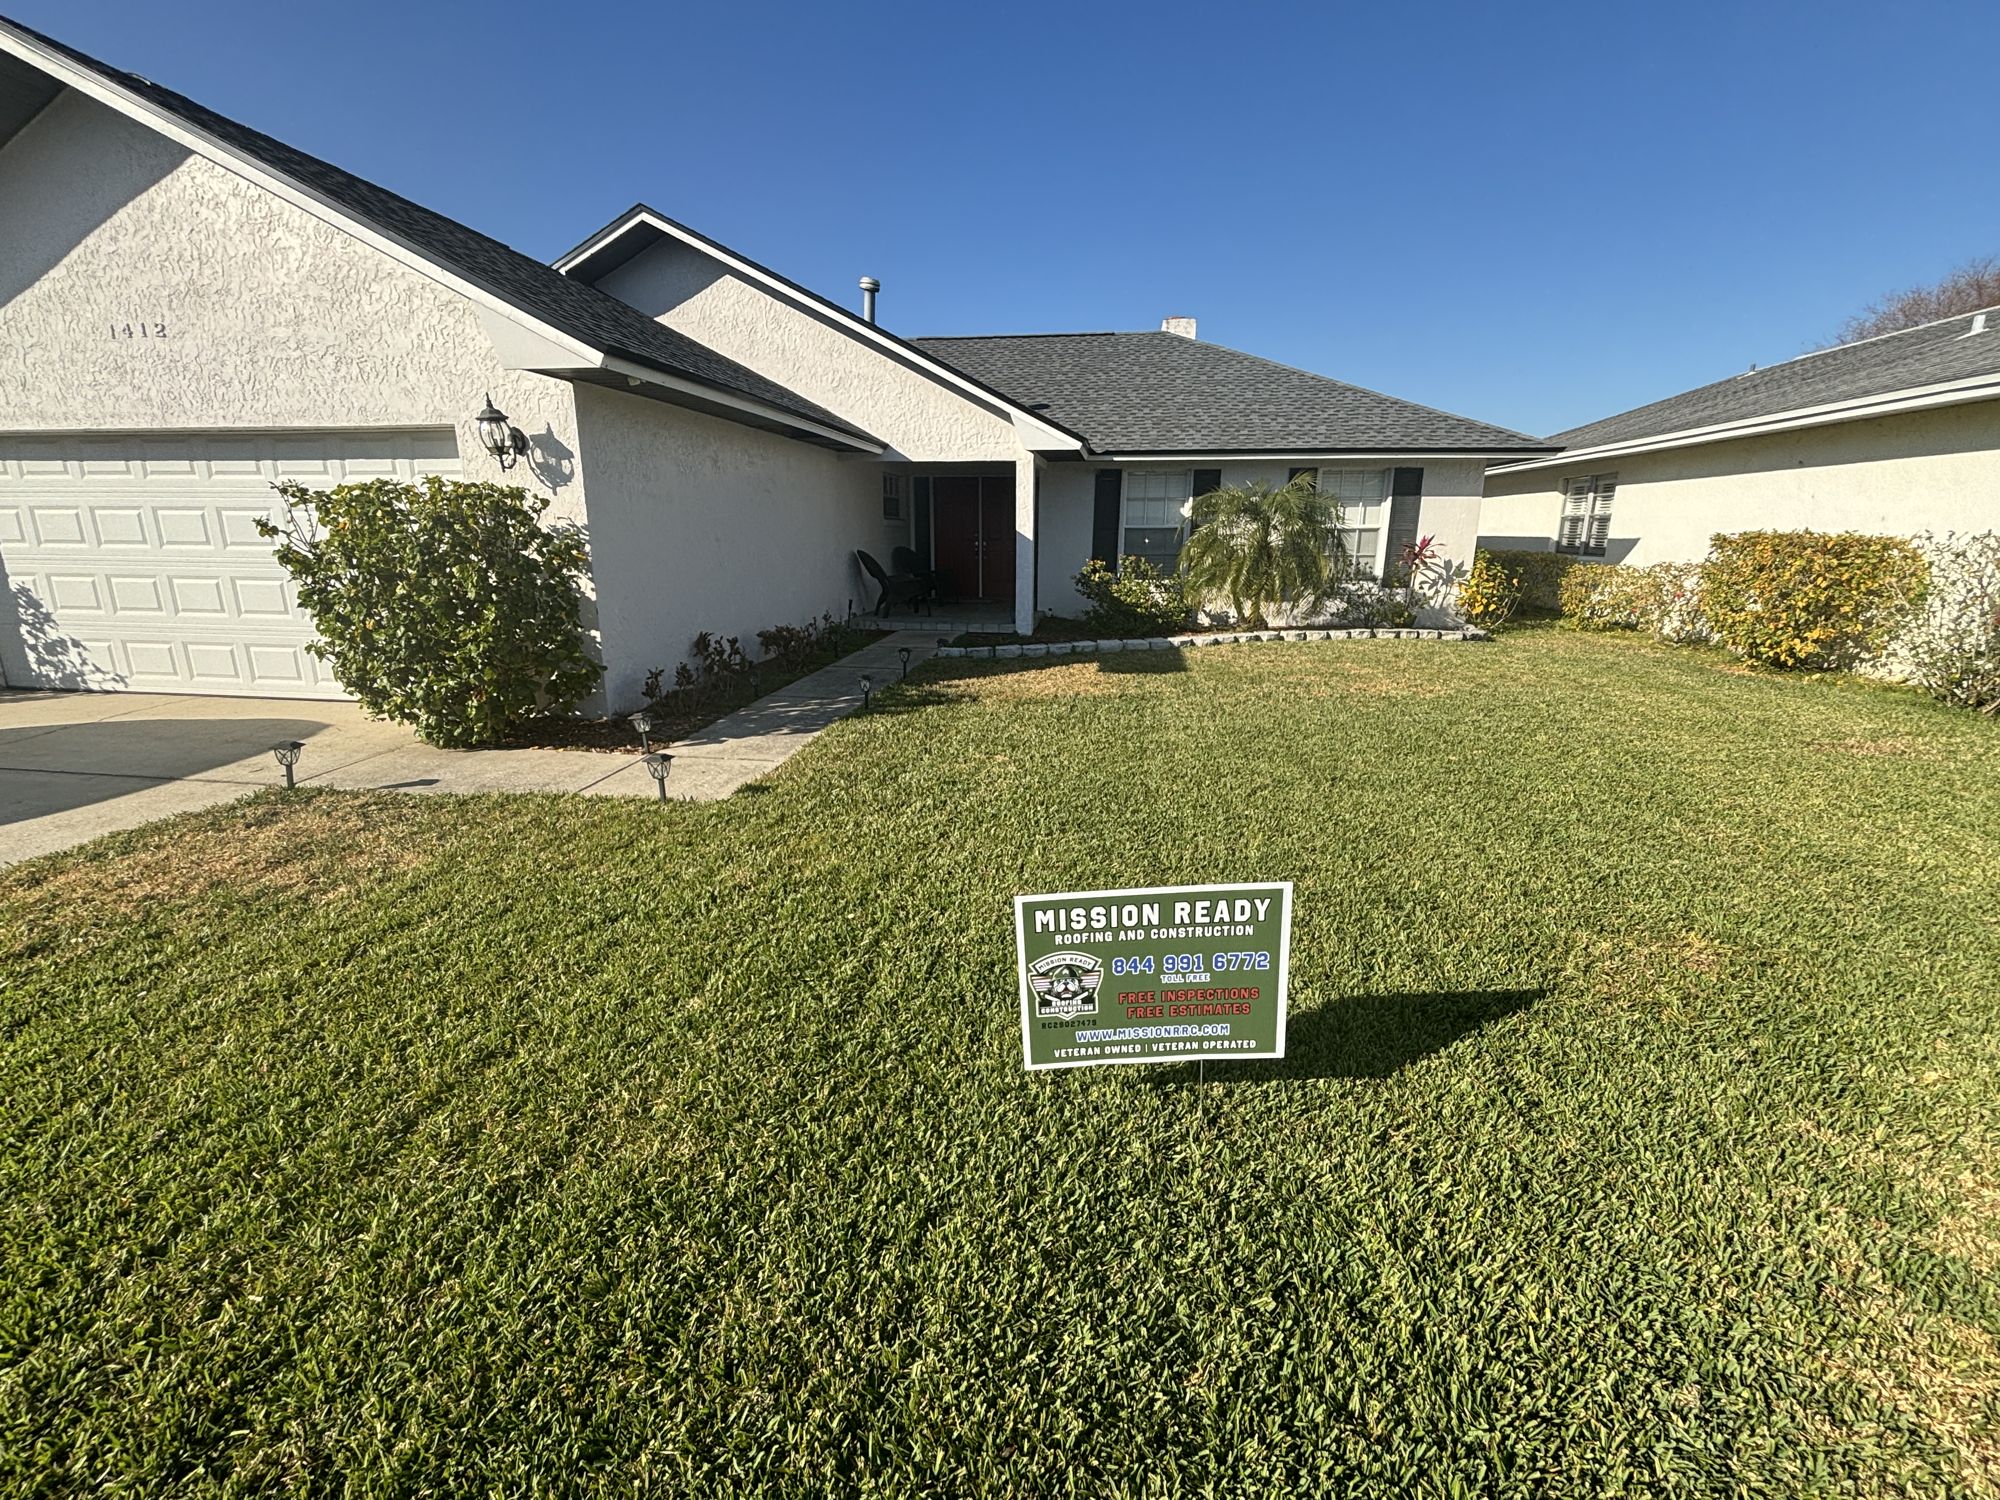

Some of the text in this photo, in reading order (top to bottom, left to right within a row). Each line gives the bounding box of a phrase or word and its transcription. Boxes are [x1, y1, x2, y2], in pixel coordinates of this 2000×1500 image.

[110, 322, 167, 339] 1412
[1035, 899, 1271, 932] MISSION READY
[1055, 926, 1254, 945] ROOFING AND CONSTRUCTION
[1069, 957, 1092, 967] READY
[1112, 952, 1270, 975] 844 991 6772
[1160, 974, 1210, 983] TOLL FREE
[1118, 988, 1260, 1004] FREE INSPECTIONS
[1127, 1004, 1250, 1019] FREE ESTIMATES
[1076, 1024, 1230, 1042] WWW.MISSIONRRC.COM
[1054, 1047, 1100, 1058] VETERAN
[1104, 1044, 1141, 1054] OWNED
[1152, 1042, 1198, 1052] VETERAN
[1203, 1040, 1256, 1050] OPERATED
